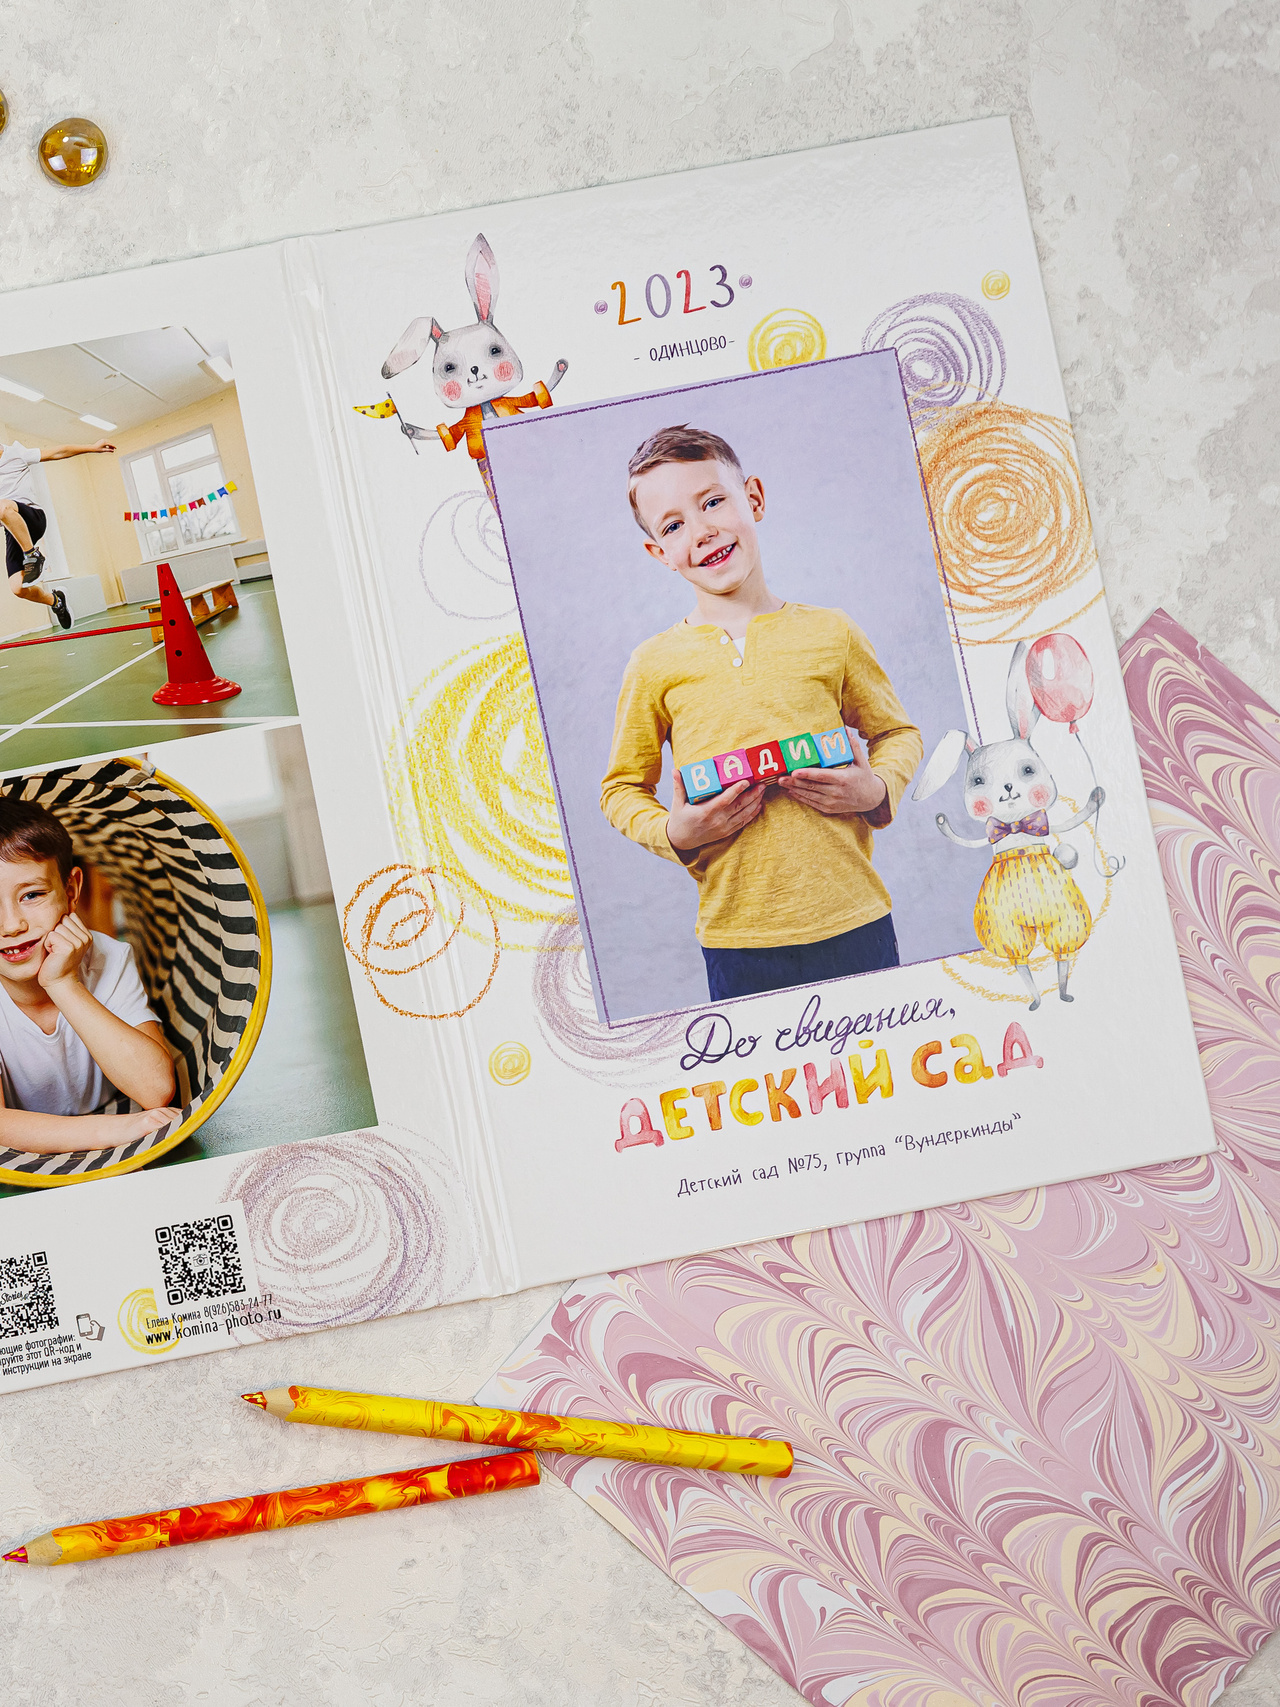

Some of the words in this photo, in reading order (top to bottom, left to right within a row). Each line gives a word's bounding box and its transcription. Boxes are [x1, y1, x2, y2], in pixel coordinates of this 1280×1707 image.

[611, 264, 735, 326] 2023
[689, 731, 847, 792] ВАДИМ
[680, 1012, 764, 1071] До
[614, 1039, 895, 1153] ДЕТСКИЙ
[677, 1169, 742, 1198] Детский
[752, 1164, 780, 1182] сад
[788, 1153, 829, 1175] №75,
[836, 1143, 887, 1167] группа
[25, 1333, 76, 1351] фотографии:
[145, 1317, 170, 1329] Елена
[171, 1310, 201, 1323] Комина
[145, 1308, 282, 1345] www.komina-photo.ru
[2, 1360, 50, 1376] инструкции
[51, 1357, 62, 1367] на
[63, 1351, 92, 1366] экране
[26, 1350, 42, 1361] этот
[43, 1344, 75, 1358] QR-код
[76, 1342, 82, 1351] и
